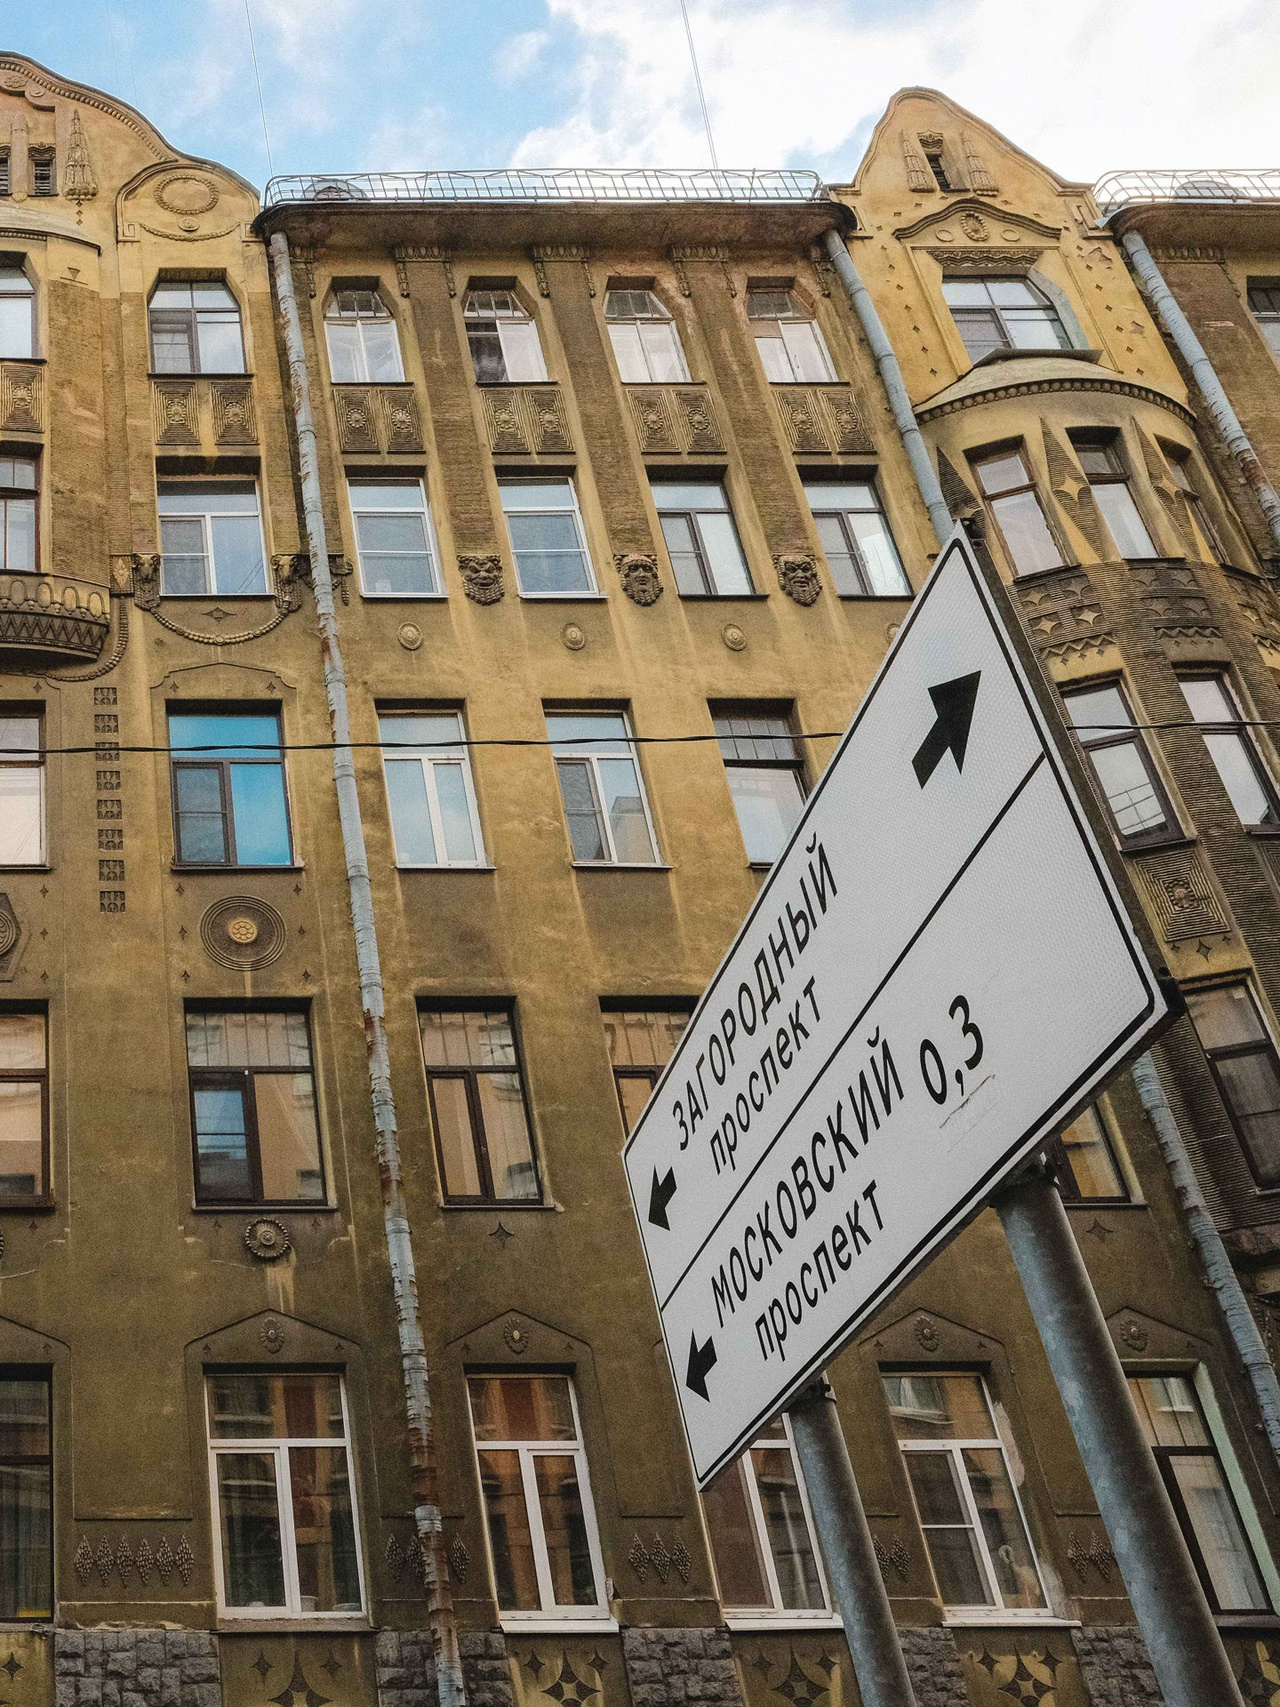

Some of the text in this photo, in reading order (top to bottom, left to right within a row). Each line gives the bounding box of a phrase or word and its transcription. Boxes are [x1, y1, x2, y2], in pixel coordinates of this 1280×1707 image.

[672, 831, 838, 1151] ЗАГОРОДНЫЙ
[709, 976, 821, 1175] проспект
[711, 994, 984, 1329] МОСКОВСКИЙ 0,3
[754, 1179, 884, 1362] проспект
